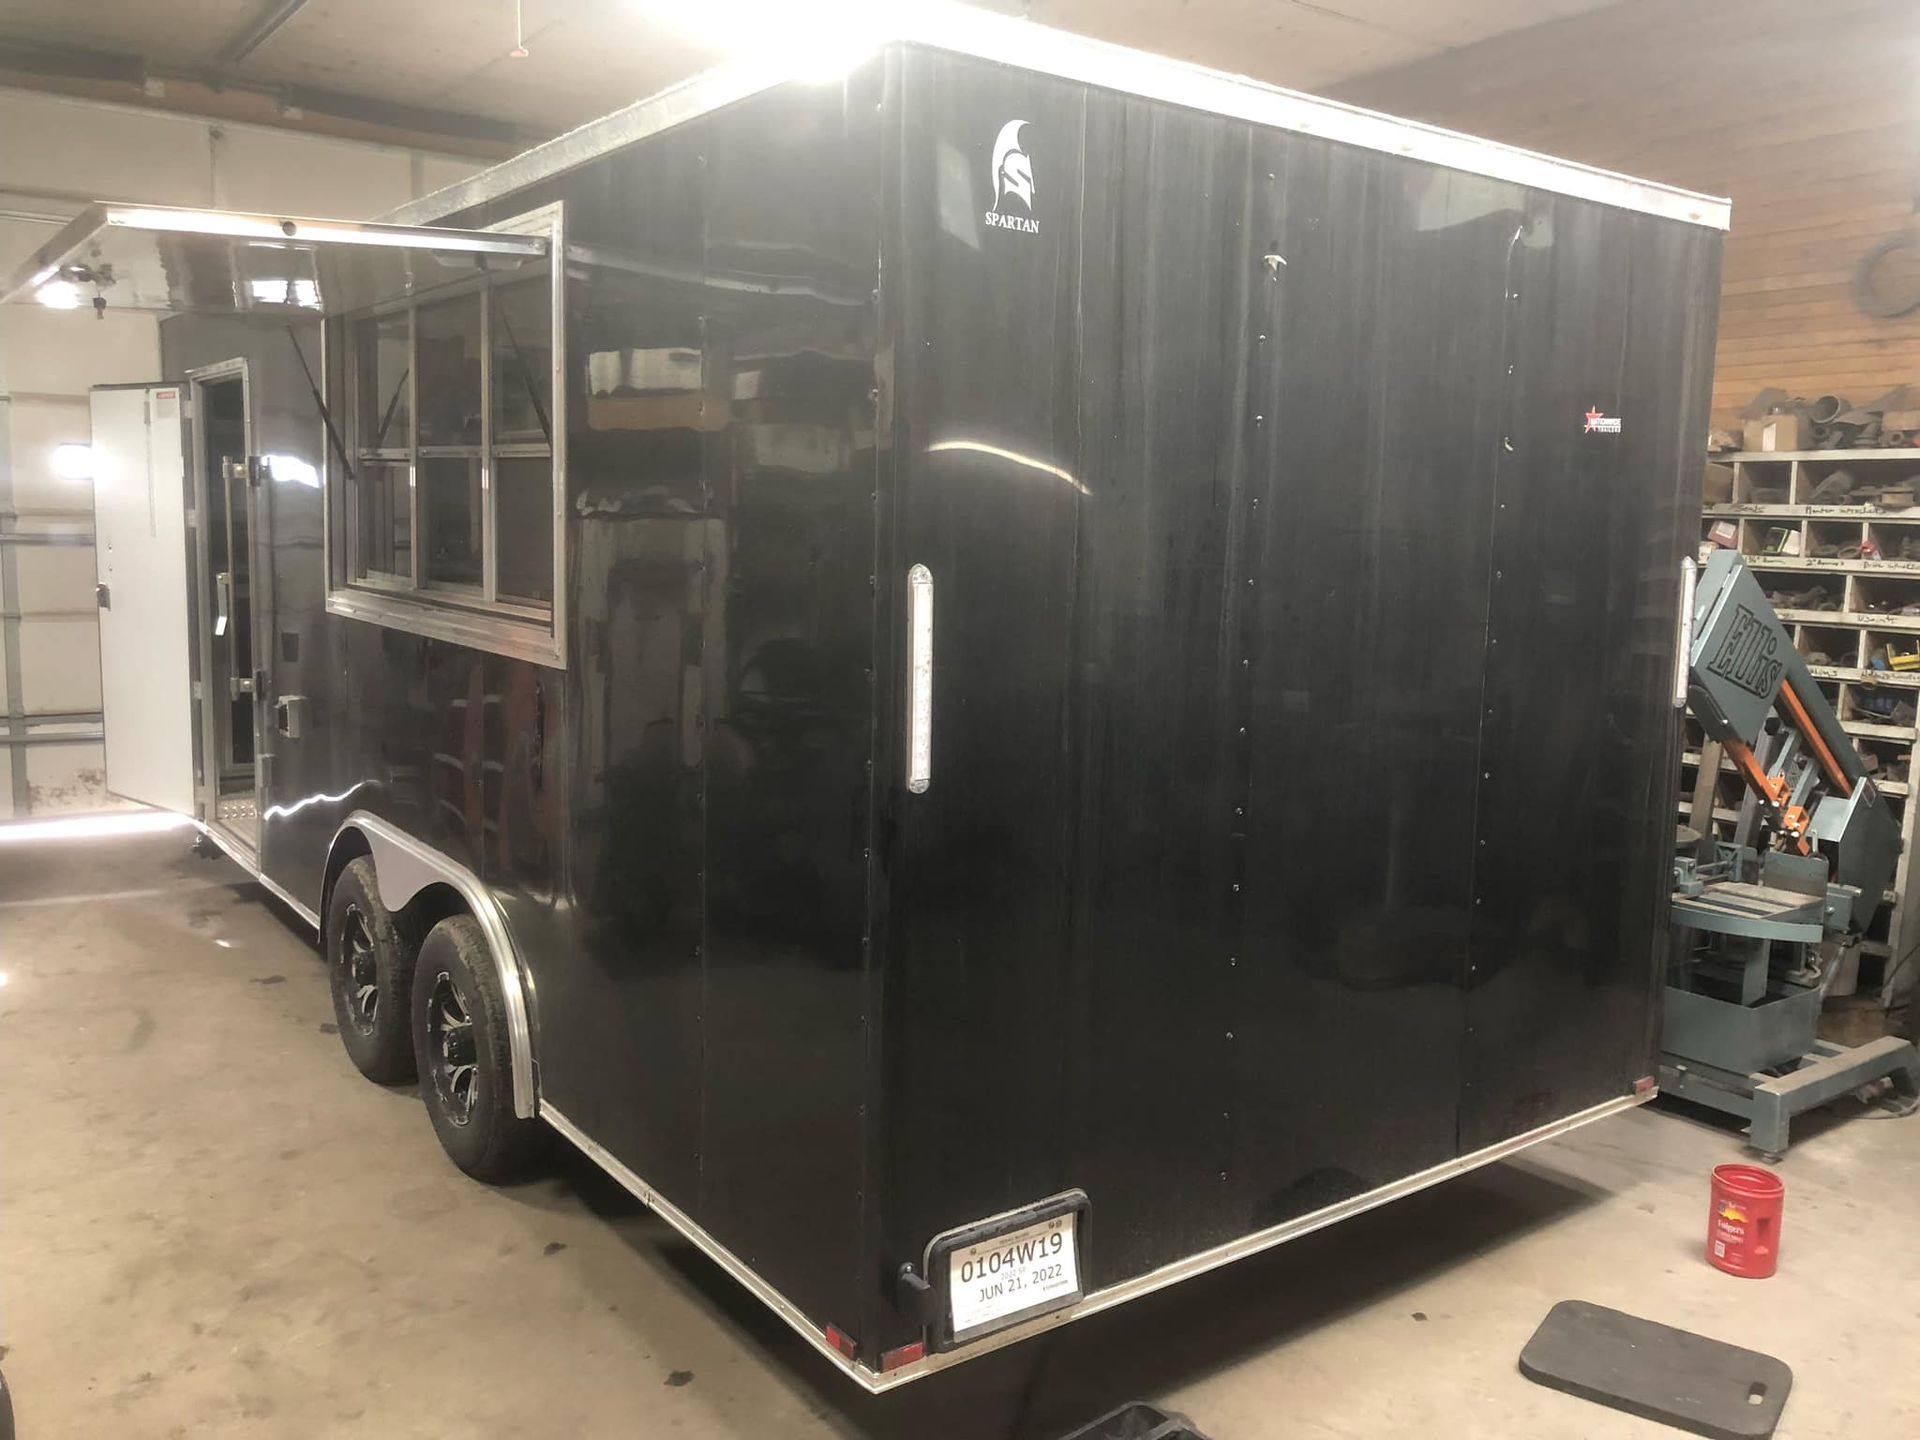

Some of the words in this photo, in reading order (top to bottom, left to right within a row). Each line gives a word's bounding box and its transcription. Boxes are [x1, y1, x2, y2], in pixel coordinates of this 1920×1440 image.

[985, 211, 1040, 233] SPARTAN
[961, 1232, 1063, 1283] 0104W19
[979, 1284, 1004, 1302] JUN
[1008, 1277, 1028, 1292] 21,
[1032, 1264, 1063, 1285] 2022
